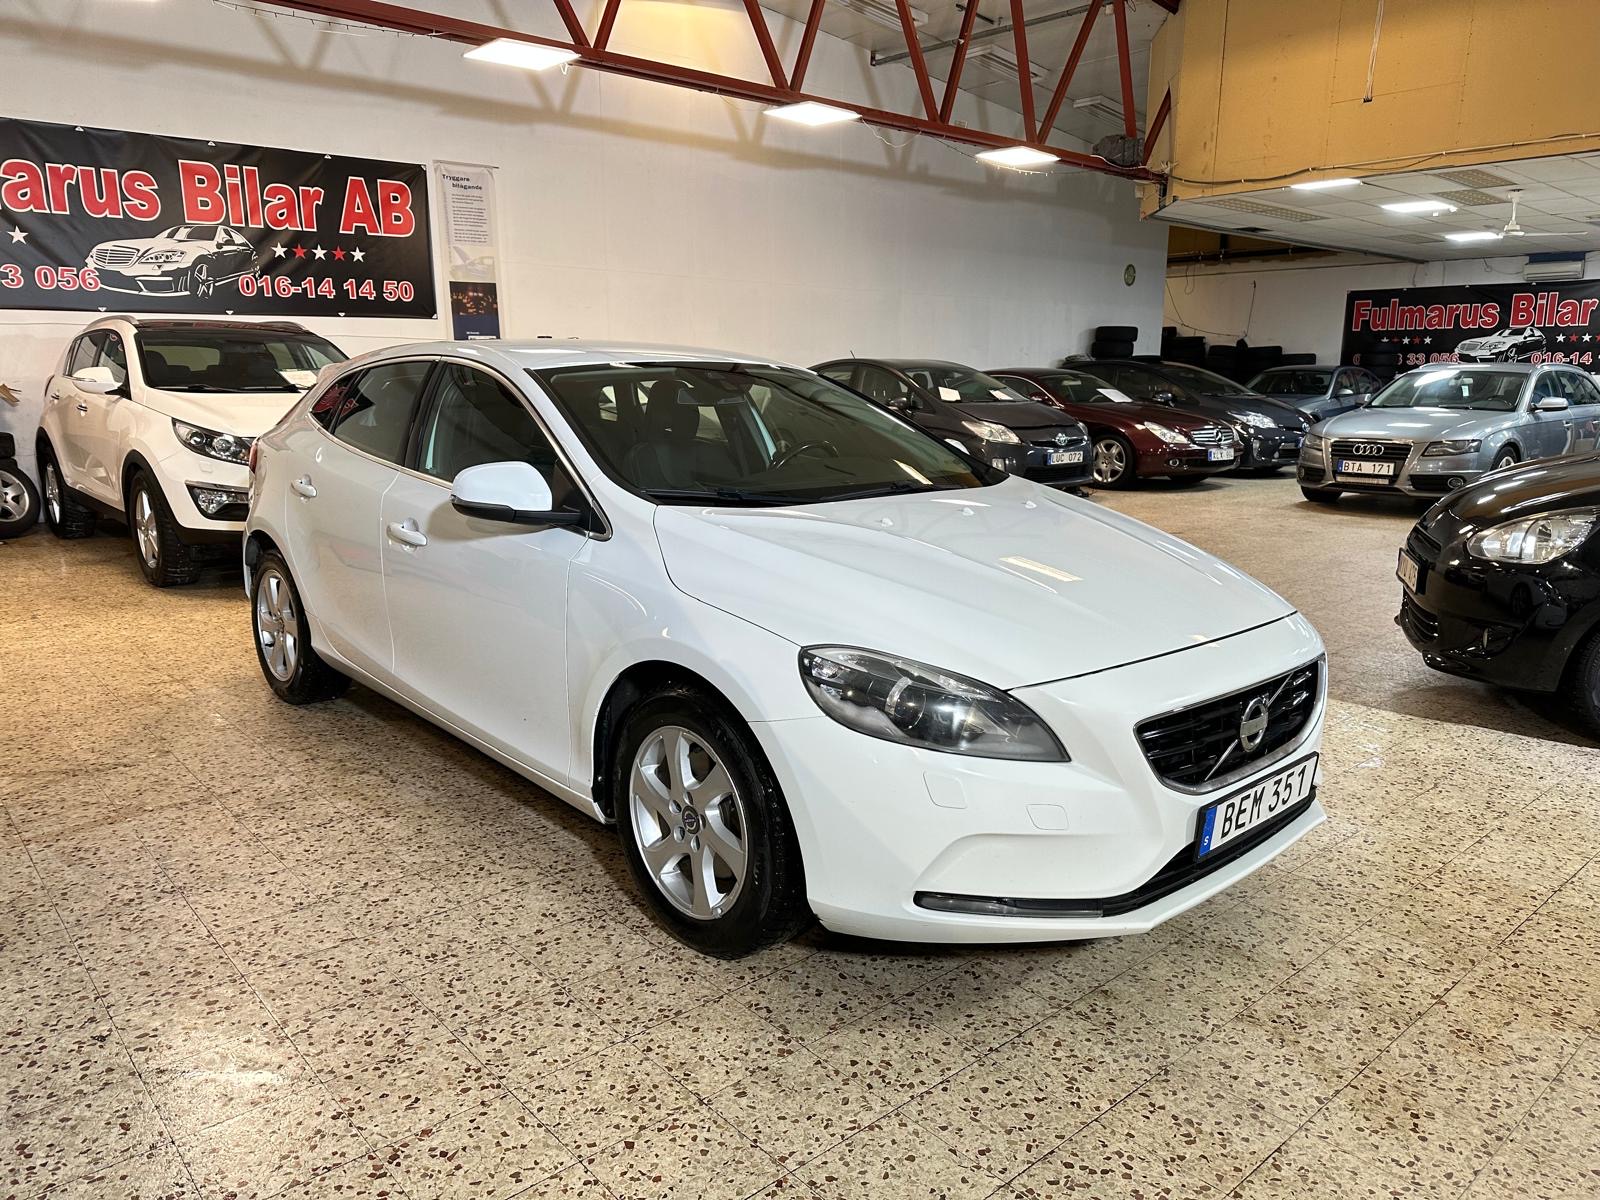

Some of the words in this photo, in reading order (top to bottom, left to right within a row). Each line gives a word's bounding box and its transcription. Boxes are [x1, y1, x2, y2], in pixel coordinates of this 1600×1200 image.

[0, 159, 161, 221] arus
[178, 160, 324, 232] Bilar
[339, 176, 415, 238] AB
[34, 266, 101, 291] 056
[238, 275, 336, 299] 016-14
[343, 278, 376, 300] 14
[383, 280, 414, 302] 50
[1352, 298, 1500, 332] Fulmarus
[1510, 291, 1599, 328] Bilar
[1406, 352, 1426, 366] 33
[1429, 352, 1460, 364] 056
[1531, 351, 1593, 365] 016-14
[1069, 452, 1082, 462] 072
[1343, 461, 1363, 473] BTA
[1372, 463, 1391, 474] 171
[1203, 835, 1210, 846] S
[1220, 786, 1266, 840] BEM
[1268, 764, 1308, 813] 351
